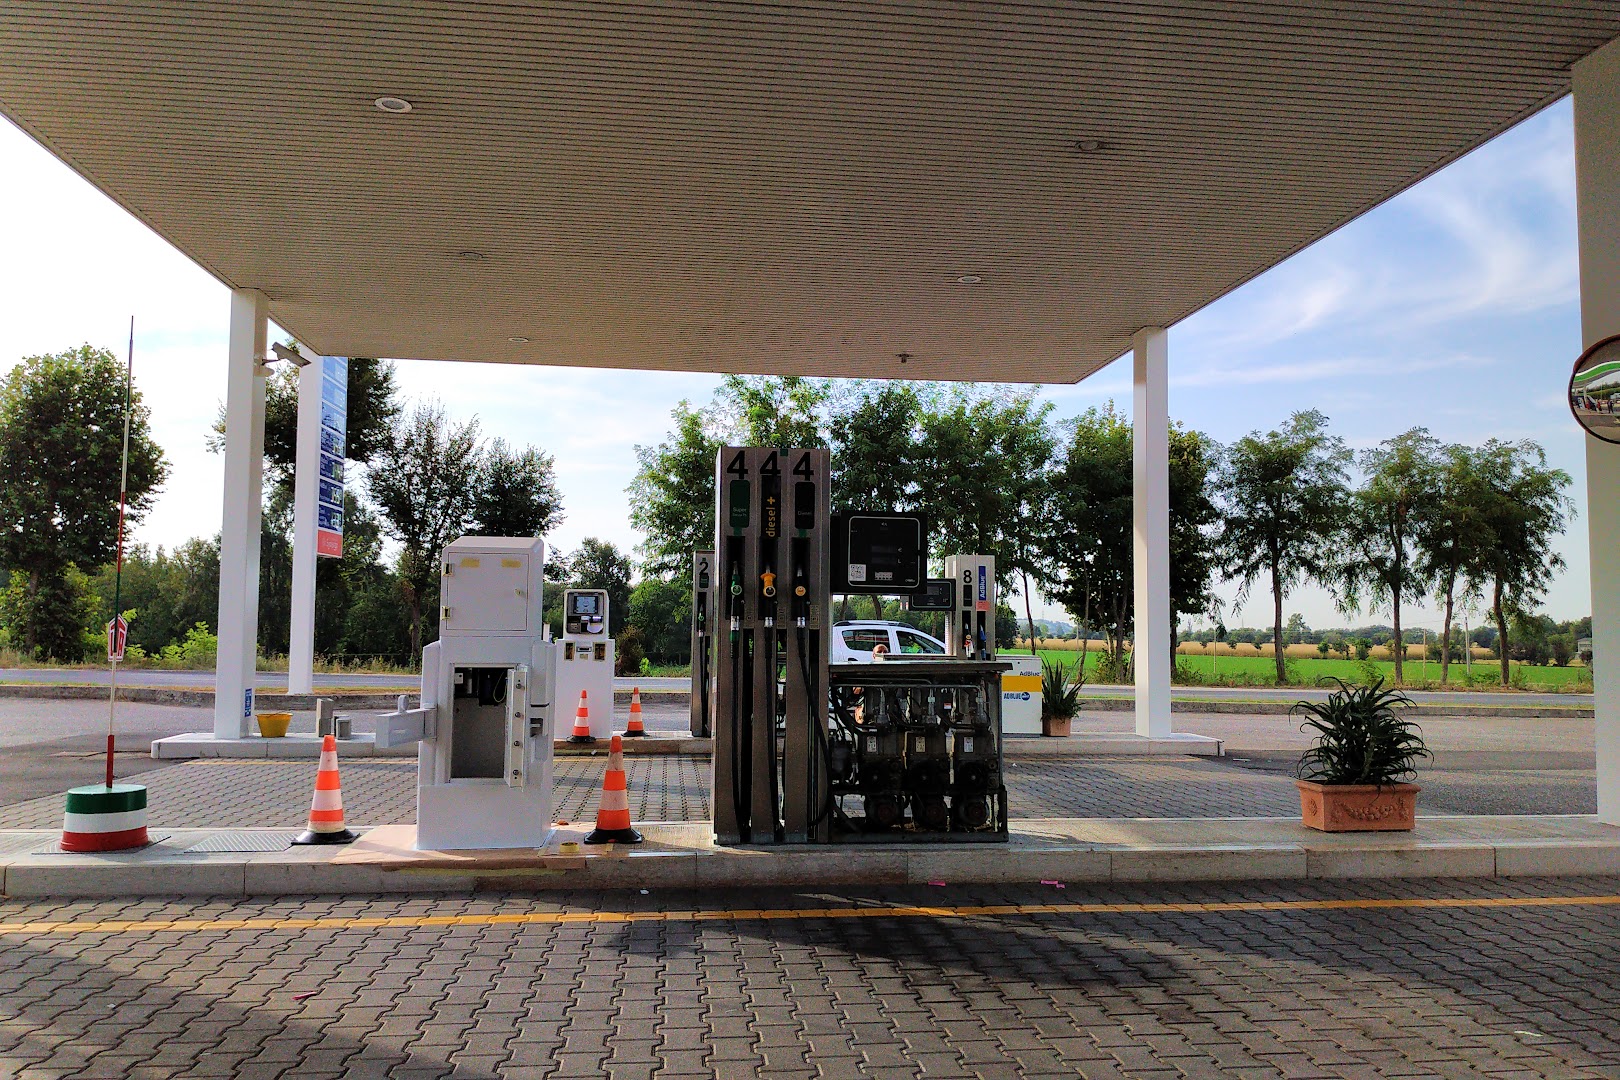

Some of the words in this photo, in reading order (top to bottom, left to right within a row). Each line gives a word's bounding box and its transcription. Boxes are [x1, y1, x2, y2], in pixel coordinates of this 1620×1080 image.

[727, 451, 748, 479] 4
[760, 451, 781, 475] 4
[793, 452, 814, 481] 4
[766, 507, 776, 537] diesel
[699, 561, 709, 576] 2
[963, 569, 972, 584] 8
